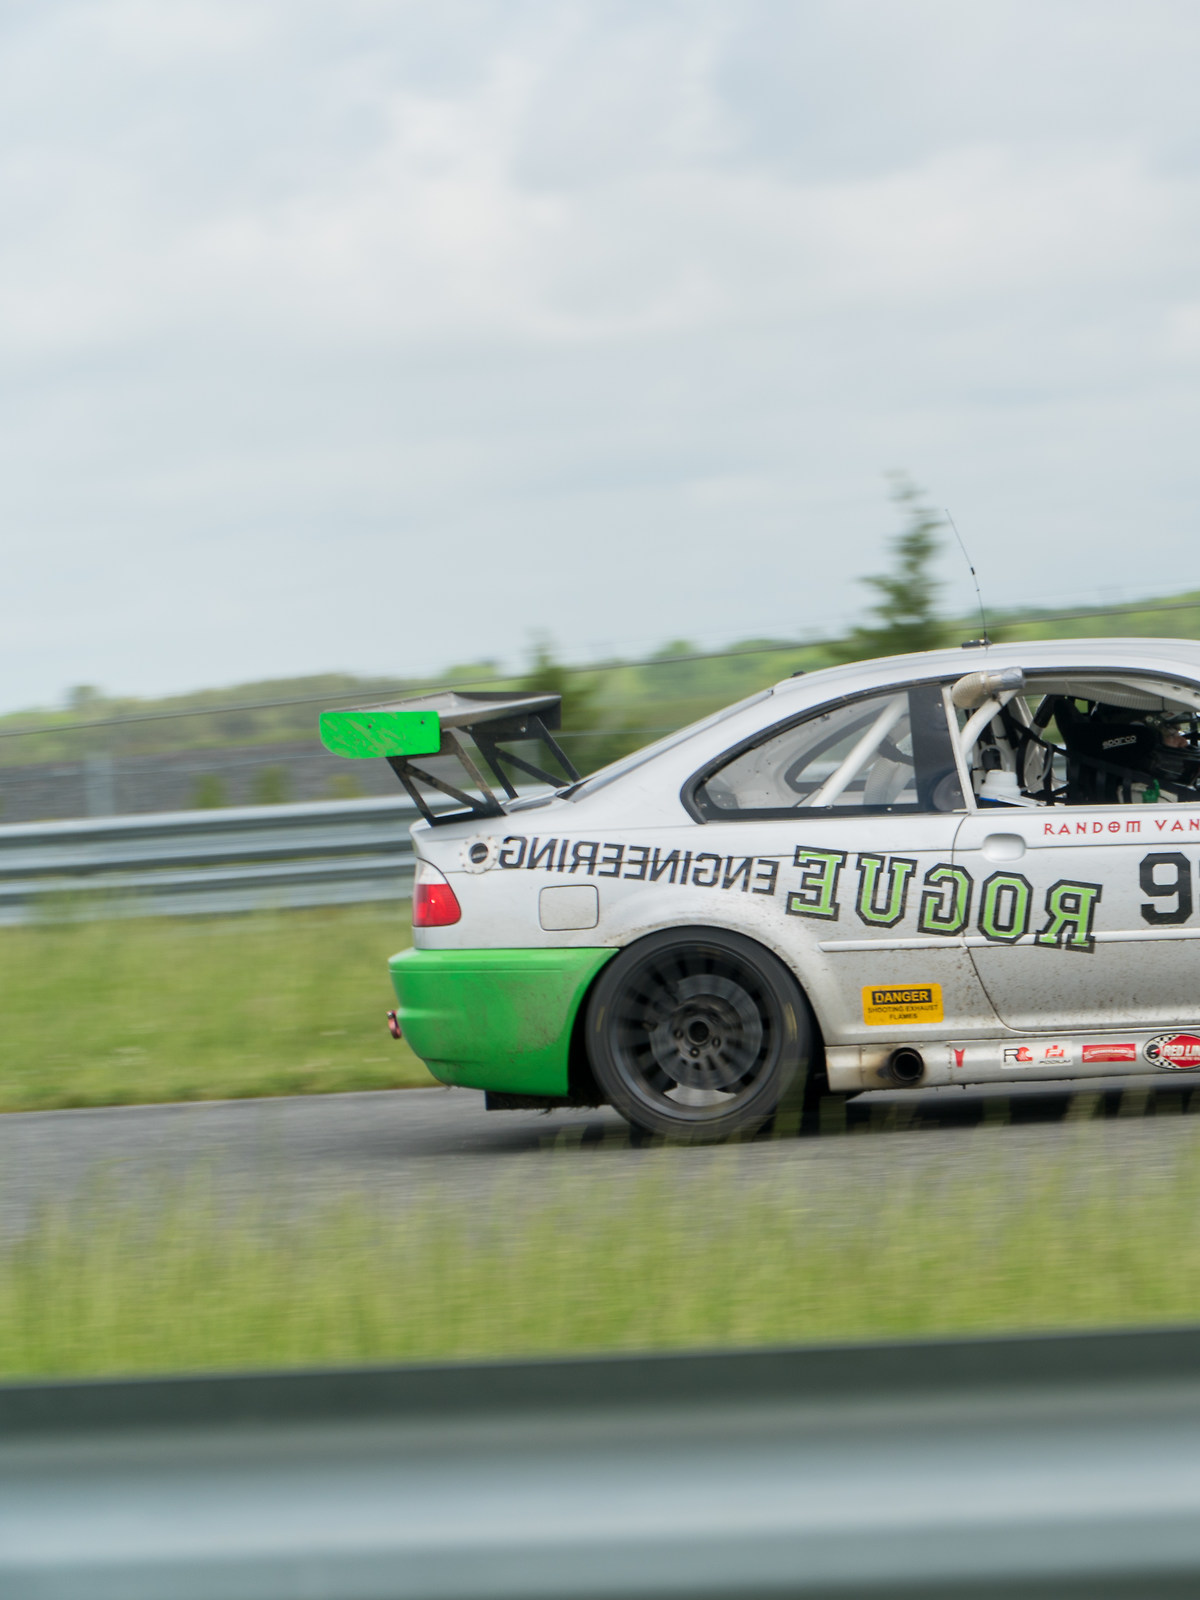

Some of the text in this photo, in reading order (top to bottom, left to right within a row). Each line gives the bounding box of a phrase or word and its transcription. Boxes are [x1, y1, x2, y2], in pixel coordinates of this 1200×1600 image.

[1043, 820, 1142, 835] RANDOM
[874, 990, 929, 1004] DANGER
[867, 1004, 938, 1014] SHOOTING EXHAUST
[1163, 1045, 1185, 1057] RED
